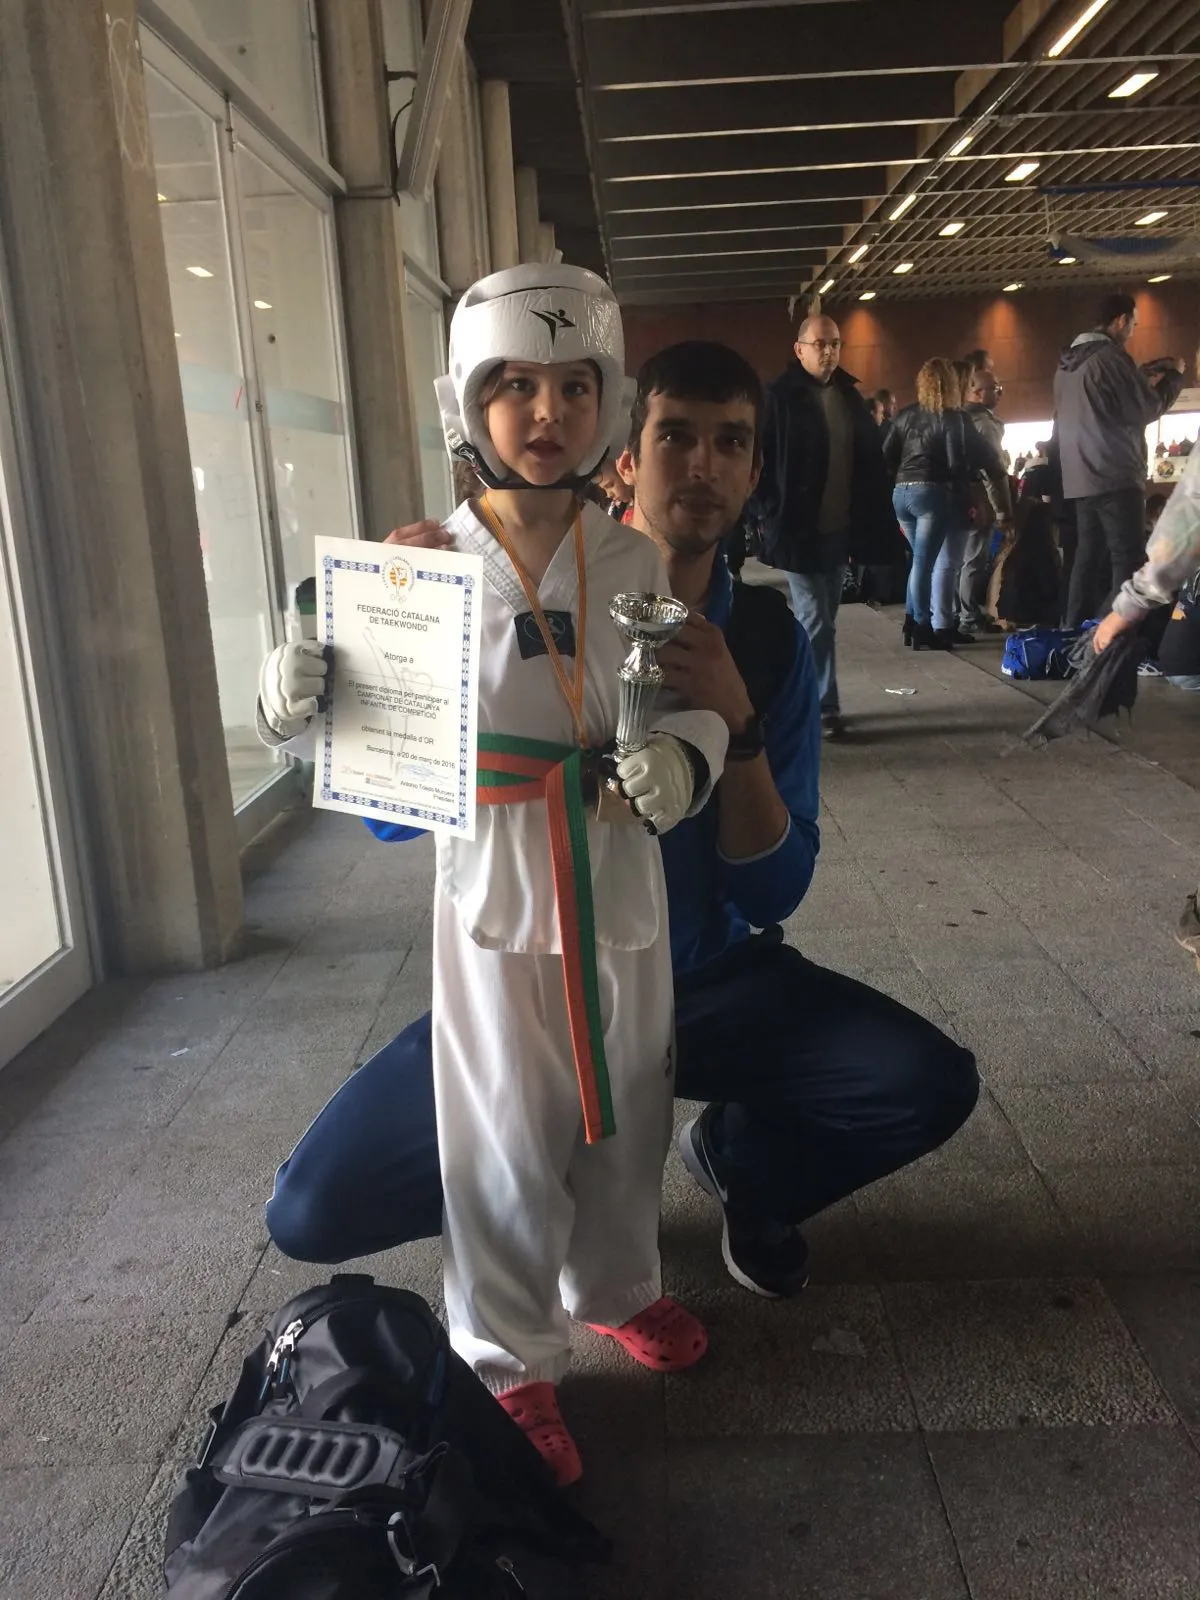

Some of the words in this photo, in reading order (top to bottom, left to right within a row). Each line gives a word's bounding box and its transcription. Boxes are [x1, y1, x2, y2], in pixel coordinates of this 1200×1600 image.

[357, 604, 400, 618] FEDERACIÓ
[401, 610, 440, 624] CATALANA
[369, 616, 379, 624] DE
[380, 617, 428, 632] TAEKWONDO
[384, 651, 408, 664] Atorga
[388, 704, 398, 712] DE
[393, 697, 403, 705] DE
[404, 699, 440, 711] CATALUNYA
